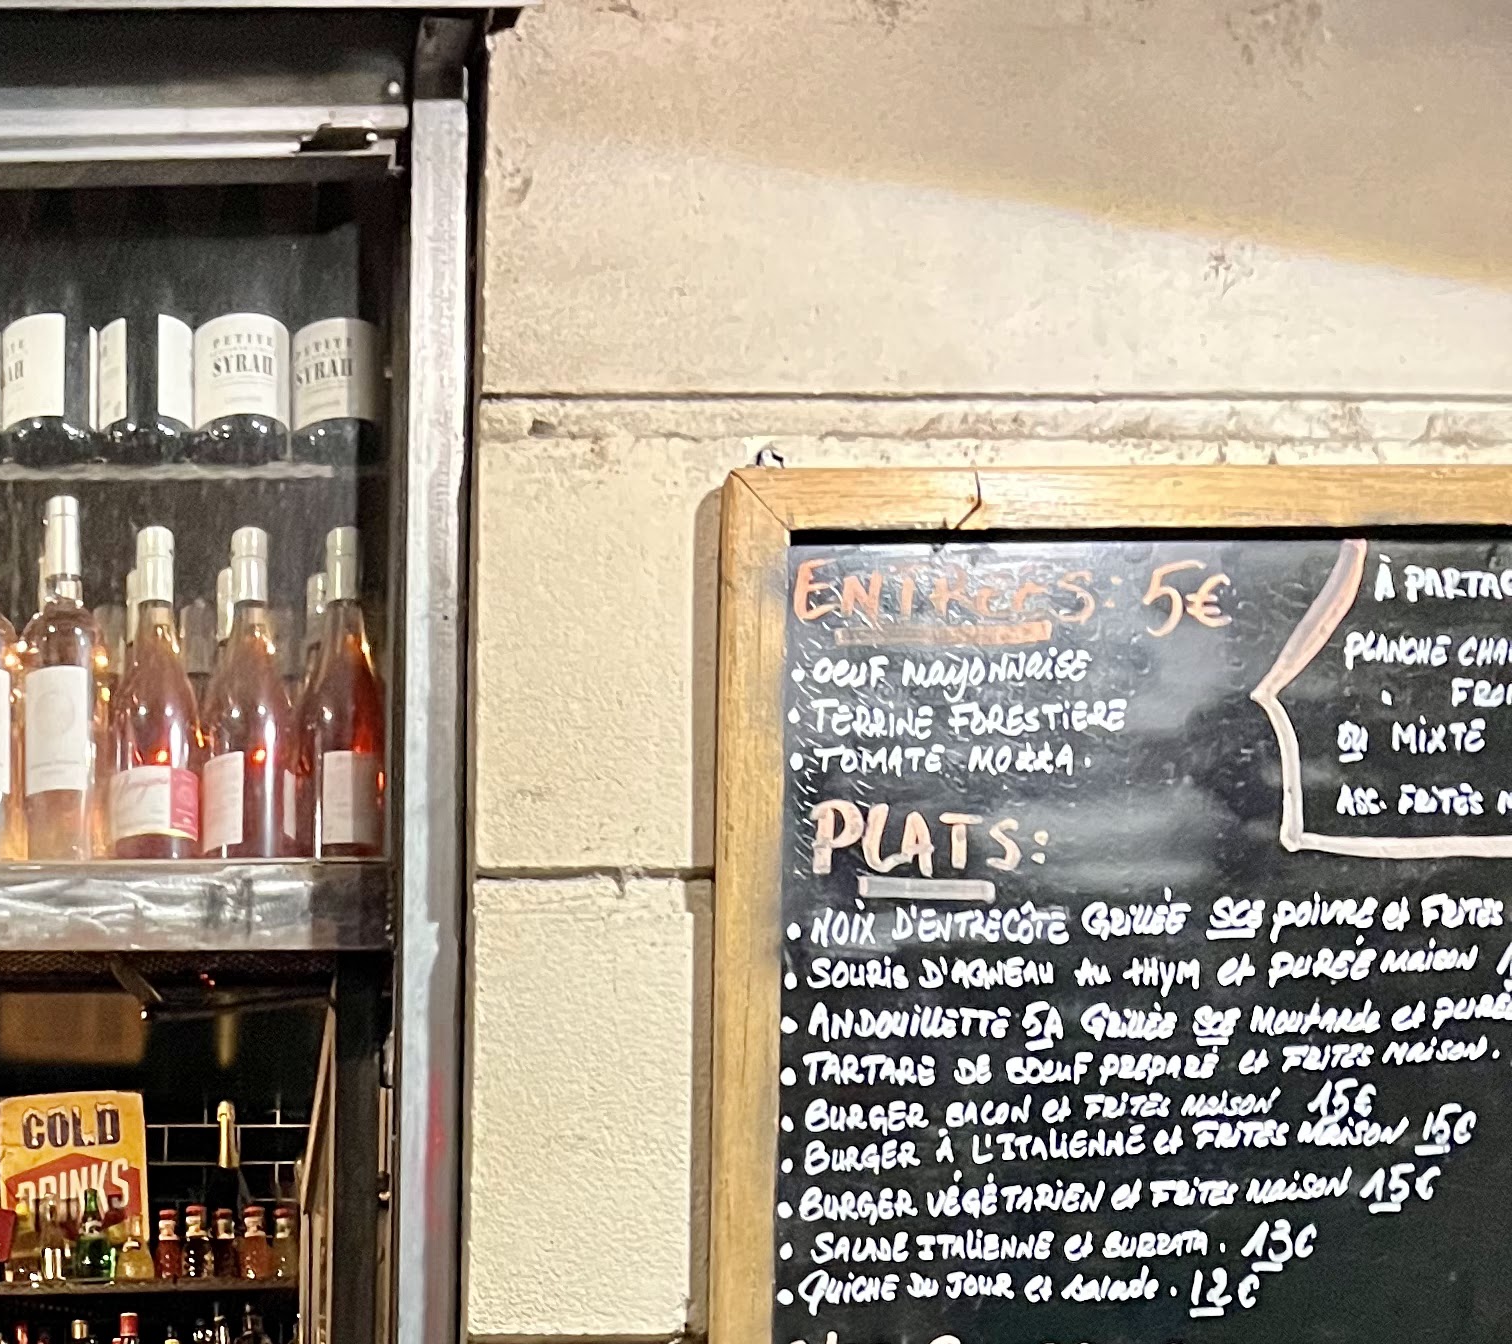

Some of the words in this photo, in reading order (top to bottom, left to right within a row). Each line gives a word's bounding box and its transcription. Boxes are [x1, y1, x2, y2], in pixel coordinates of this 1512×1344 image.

[213, 333, 273, 349] PETITE
[213, 353, 273, 378] SYRAH
[296, 358, 353, 386] SYRAH
[1142, 558, 1234, 638] 5€
[814, 743, 945, 778] TOMATE
[802, 1050, 937, 1087] TARTARE
[954, 1053, 994, 1086] DE
[22, 1102, 121, 1149] COLD
[804, 1097, 930, 1137] BURGER
[803, 1138, 922, 1177] BURGER
[799, 1186, 918, 1227] BURGER
[1359, 1162, 1442, 1203] 15€
[810, 1231, 909, 1265] SALADE
[1241, 1218, 1318, 1264] 13€
[906, 1272, 940, 1300] DU
[945, 1272, 1015, 1300] JOUR
